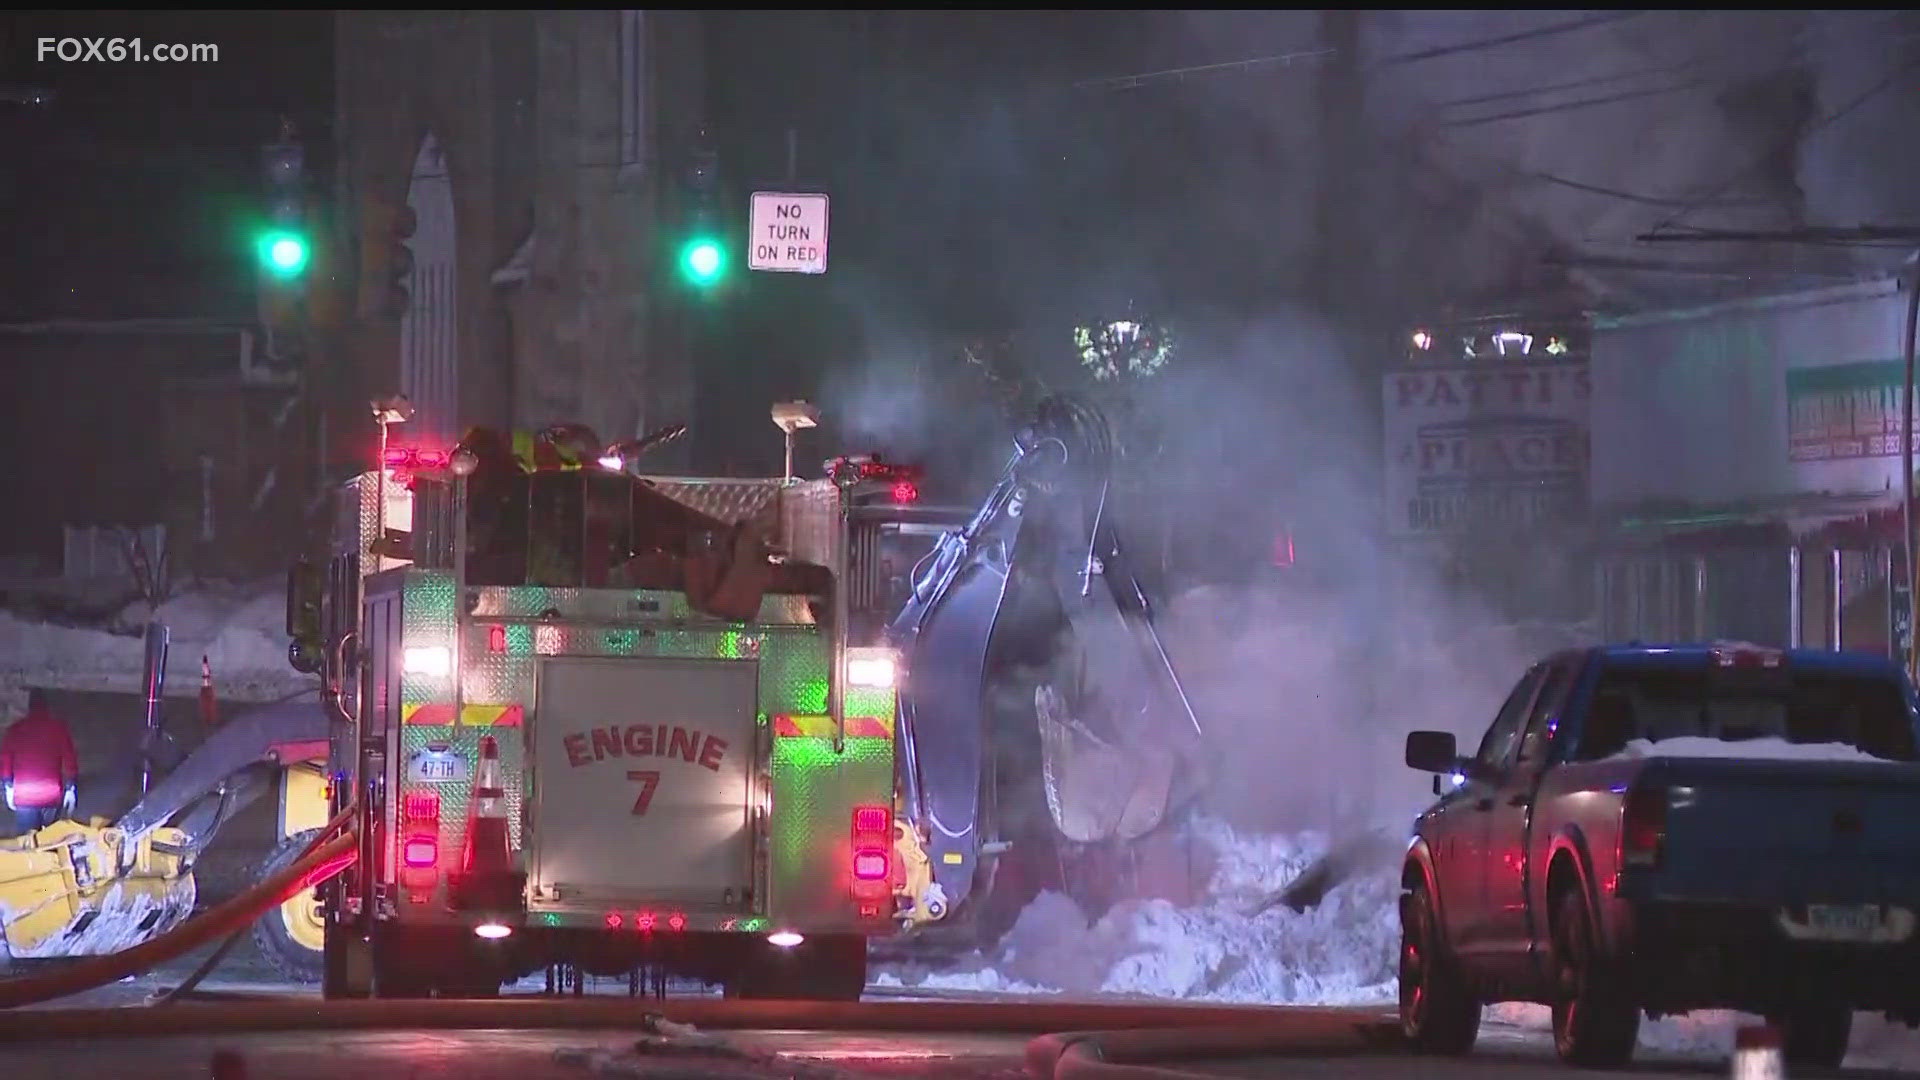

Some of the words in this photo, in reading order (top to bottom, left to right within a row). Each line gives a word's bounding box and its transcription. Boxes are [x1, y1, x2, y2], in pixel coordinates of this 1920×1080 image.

[777, 204, 802, 219] NO
[768, 225, 810, 240] TURN
[757, 245, 778, 260] ON
[787, 246, 817, 261] RED
[1397, 371, 1593, 407] PATTI'S
[563, 724, 730, 772] ENGINE
[627, 770, 660, 816] 7
